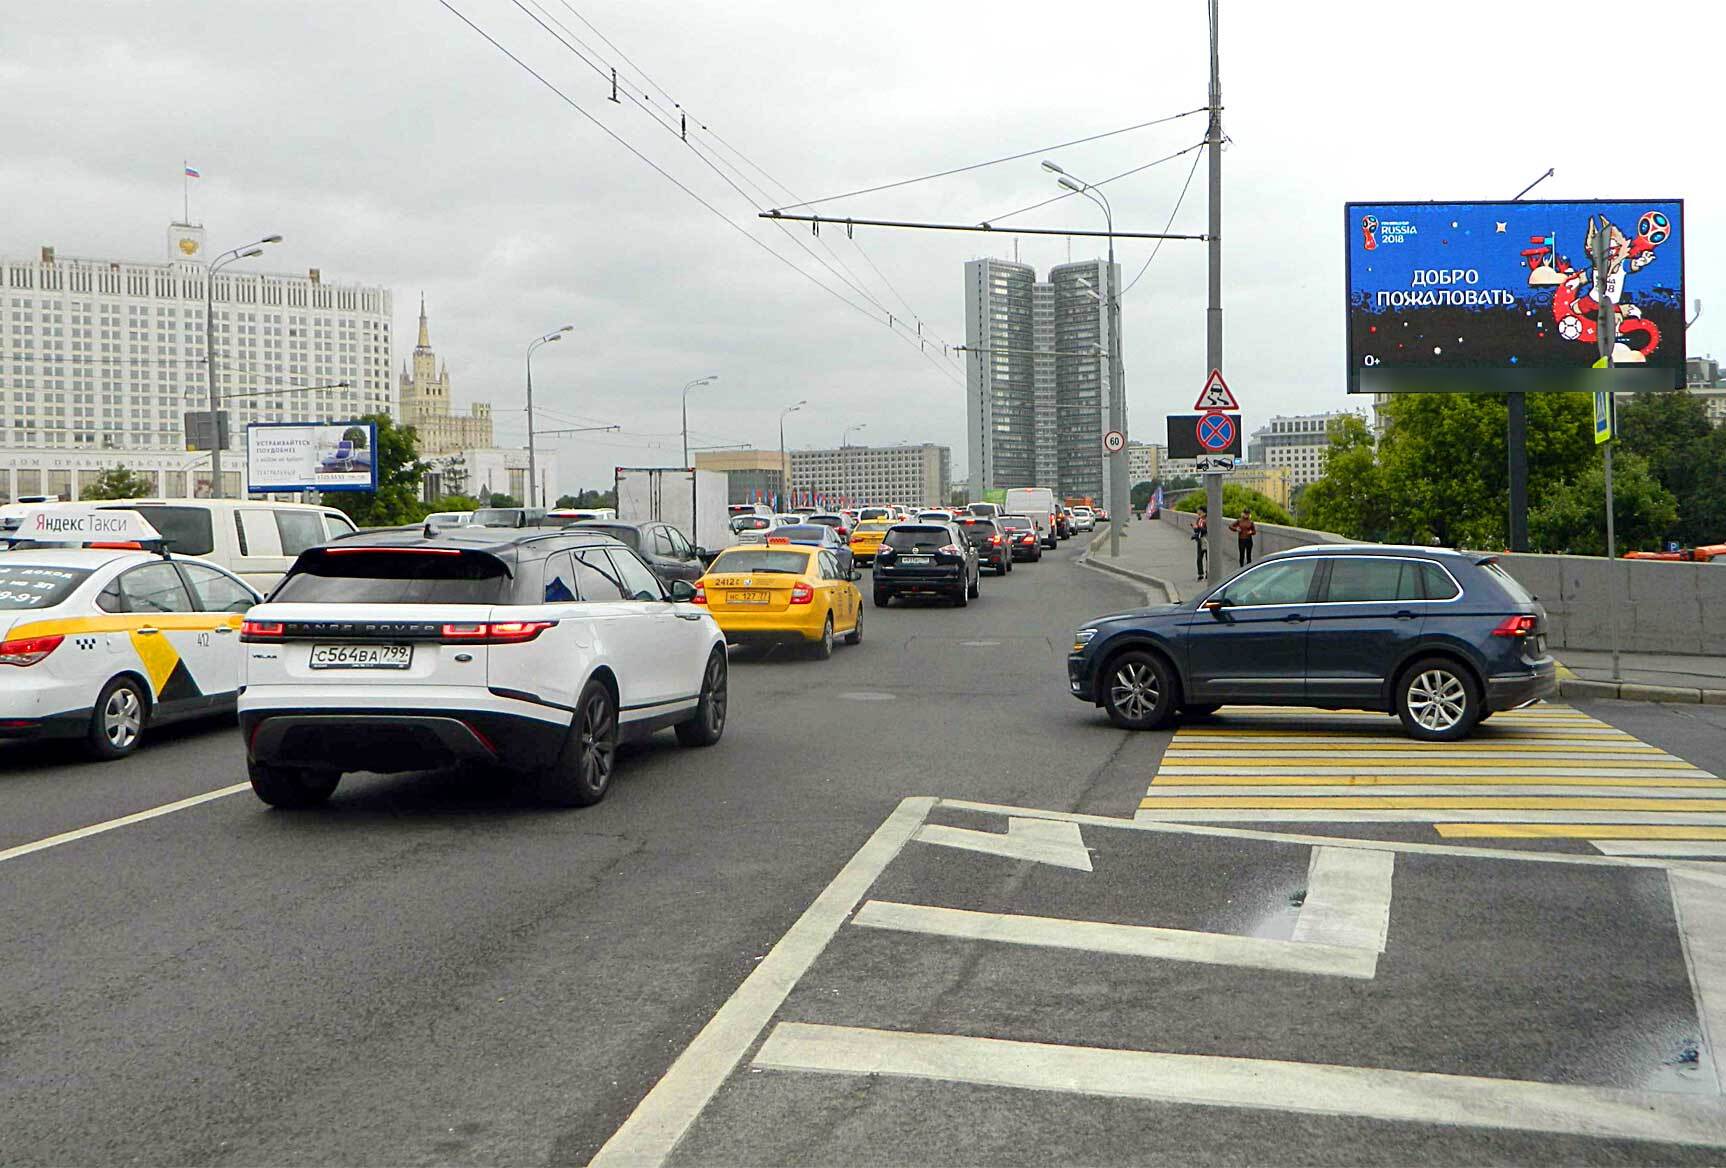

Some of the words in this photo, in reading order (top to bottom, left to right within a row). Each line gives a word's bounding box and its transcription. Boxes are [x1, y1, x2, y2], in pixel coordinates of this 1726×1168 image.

[1381, 225, 1417, 235] RUSSIA
[1381, 234, 1405, 244] 2018
[1411, 269, 1479, 287] ДОБРО
[1377, 289, 1515, 306] ПОЖАЛОВАТЬ
[1364, 354, 1381, 366] 0+
[1110, 437, 1119, 446] 60
[36, 513, 85, 533] Яндекс
[88, 514, 127, 532] Такси
[197, 632, 210, 647] 412
[316, 647, 379, 662] С564ВА
[383, 646, 407, 659] 799
